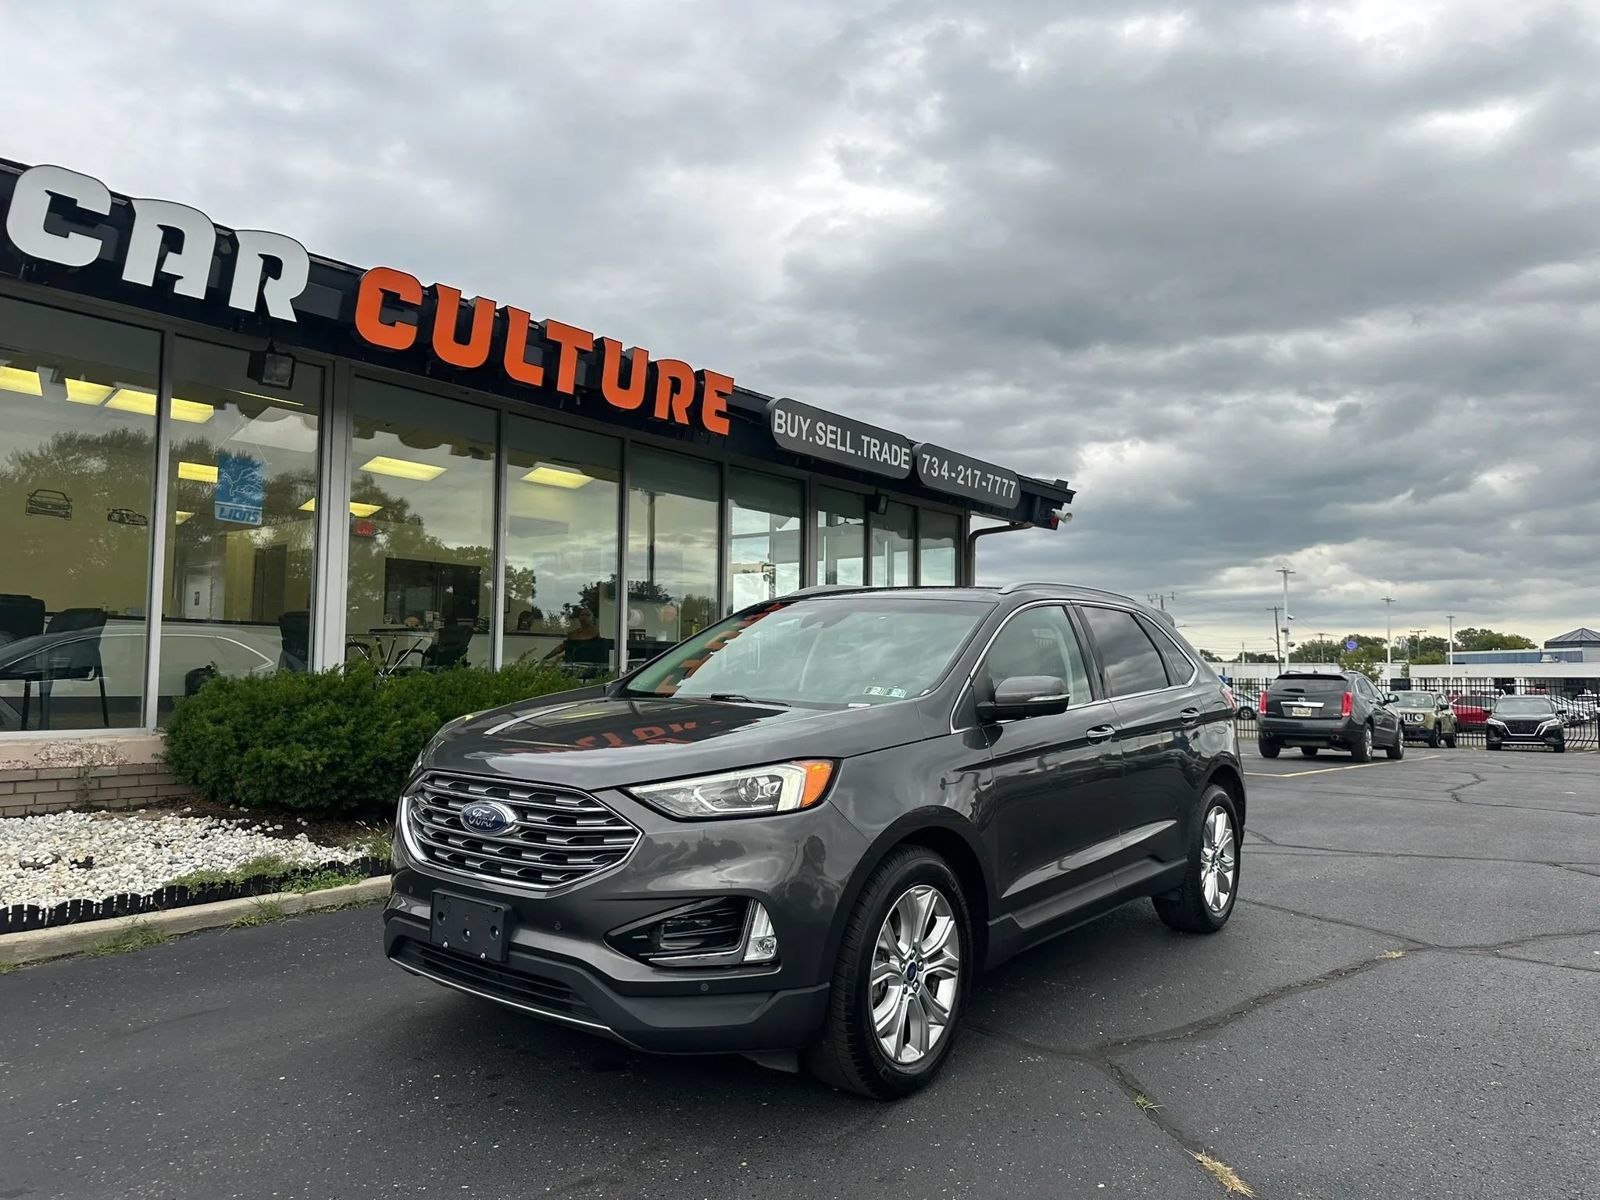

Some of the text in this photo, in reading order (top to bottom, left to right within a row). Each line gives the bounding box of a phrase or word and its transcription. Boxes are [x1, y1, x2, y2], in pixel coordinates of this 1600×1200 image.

[6, 164, 734, 436] CAR CULTURE
[921, 453, 1016, 498] 734-217-7777
[469, 807, 496, 828] Ford
